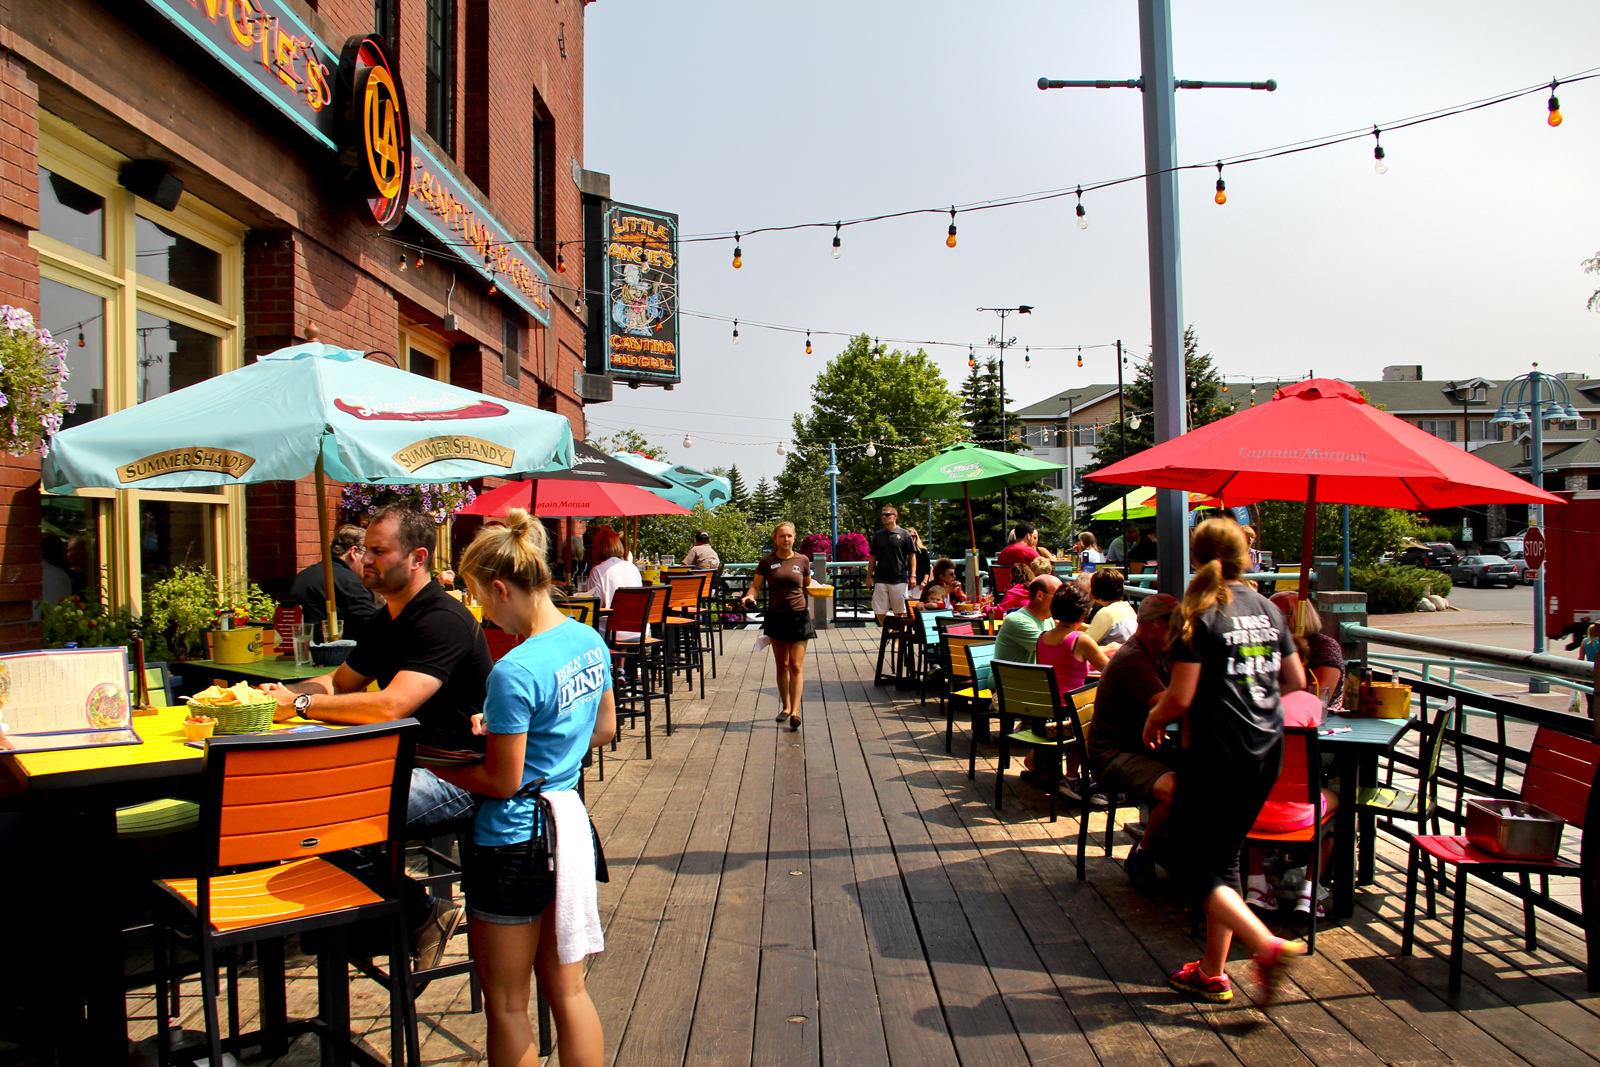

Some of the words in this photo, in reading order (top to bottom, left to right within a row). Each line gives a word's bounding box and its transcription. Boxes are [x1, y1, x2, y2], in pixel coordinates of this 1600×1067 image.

[612, 216, 669, 241] LITTLE
[608, 243, 674, 269] ANGIE'S
[609, 334, 676, 356] CANTINA
[638, 355, 676, 371] GRILL
[125, 452, 191, 479] SUMMER
[192, 449, 249, 472] SHANDY
[400, 440, 451, 468] SUMMER
[452, 437, 508, 464] SHANDY
[1239, 447, 1299, 460] Captain
[1299, 448, 1367, 463] Morgan
[556, 500, 591, 509] Morgan
[1524, 540, 1544, 557] STOP
[555, 655, 582, 686] BORN
[583, 646, 603, 665] TO
[561, 663, 605, 710] DRINK
